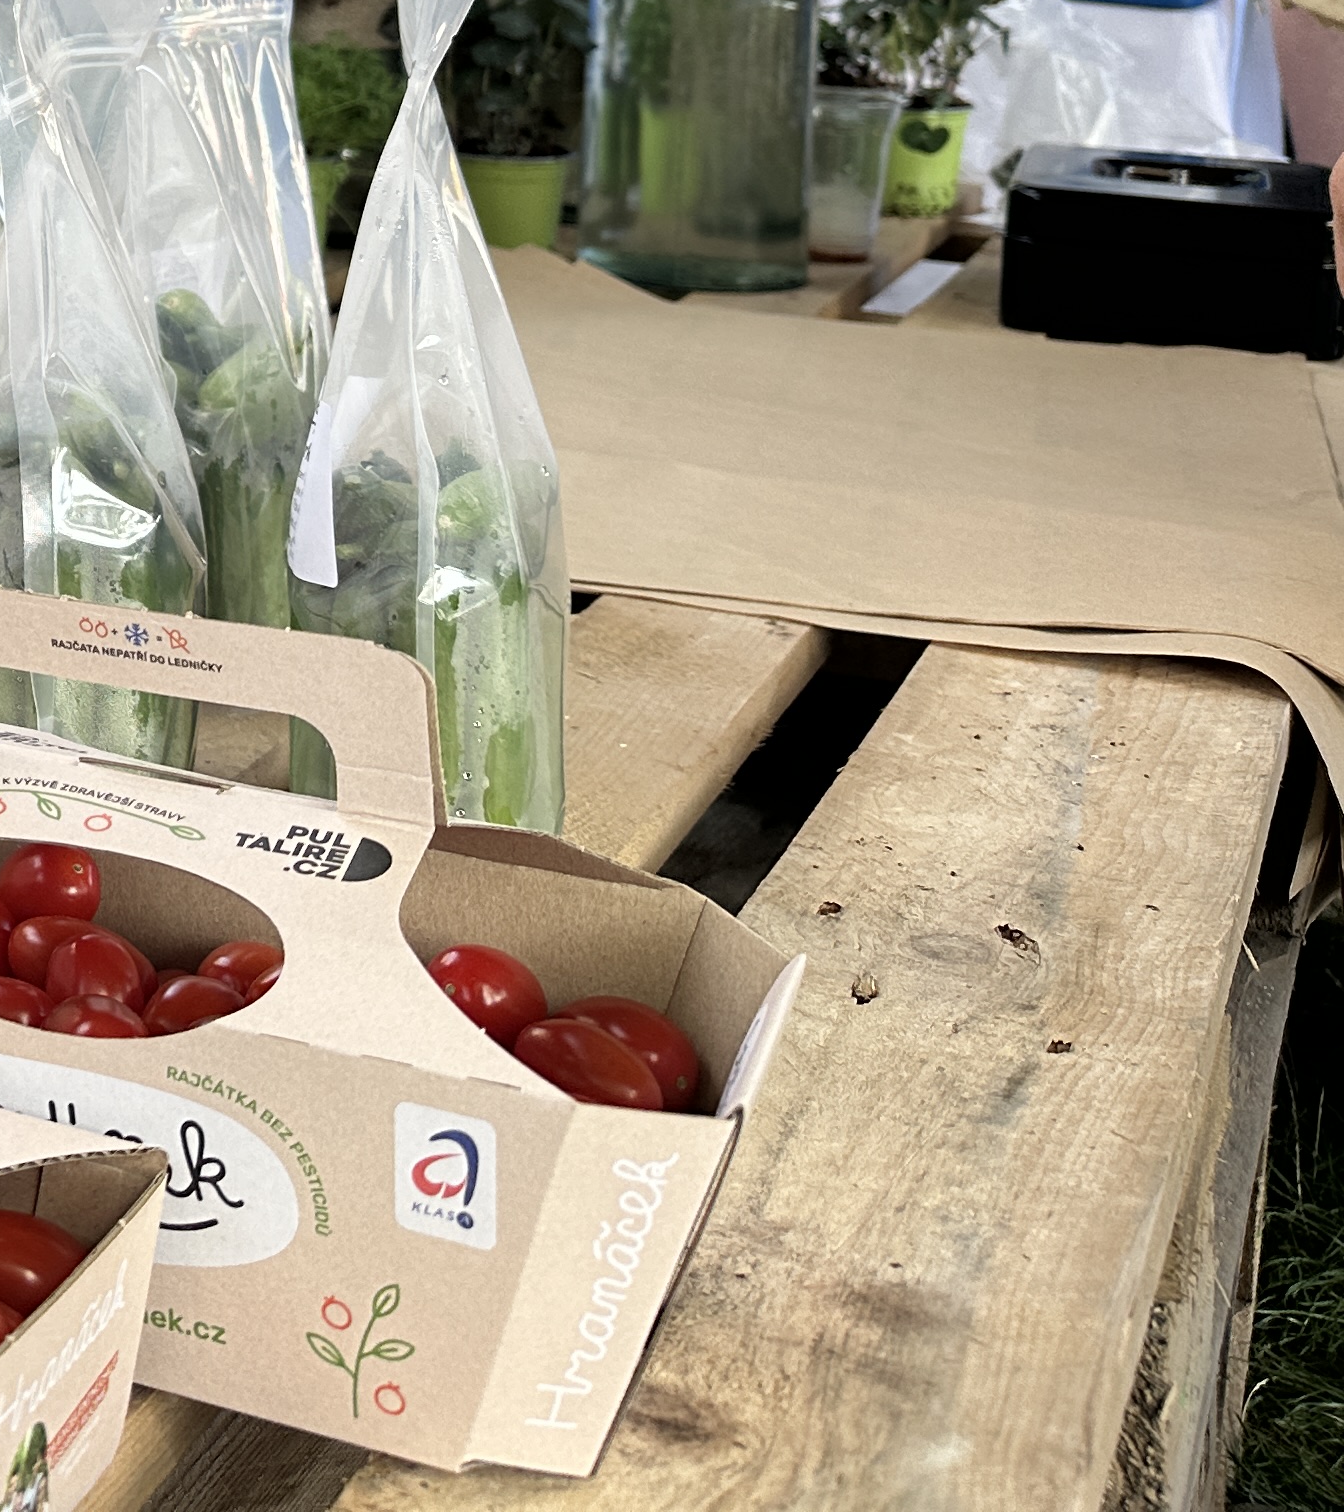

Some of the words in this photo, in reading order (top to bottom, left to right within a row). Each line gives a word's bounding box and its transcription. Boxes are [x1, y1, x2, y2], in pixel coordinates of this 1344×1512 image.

[50, 637, 100, 658] RAJČATA
[101, 644, 149, 664] NEPATŘÍ
[149, 653, 165, 665] DO
[166, 652, 223, 674] LEDNIČKY
[1, 776, 11, 785] K
[134, 798, 186, 822] STRAVY
[284, 824, 352, 850] PUL
[282, 859, 343, 881] .CZ
[166, 1065, 259, 1114] RAJČÁTKA
[258, 1107, 293, 1143] BEZ
[289, 1139, 334, 1237] PESTICIDŮ
[525, 1152, 680, 1431] Hranáček
